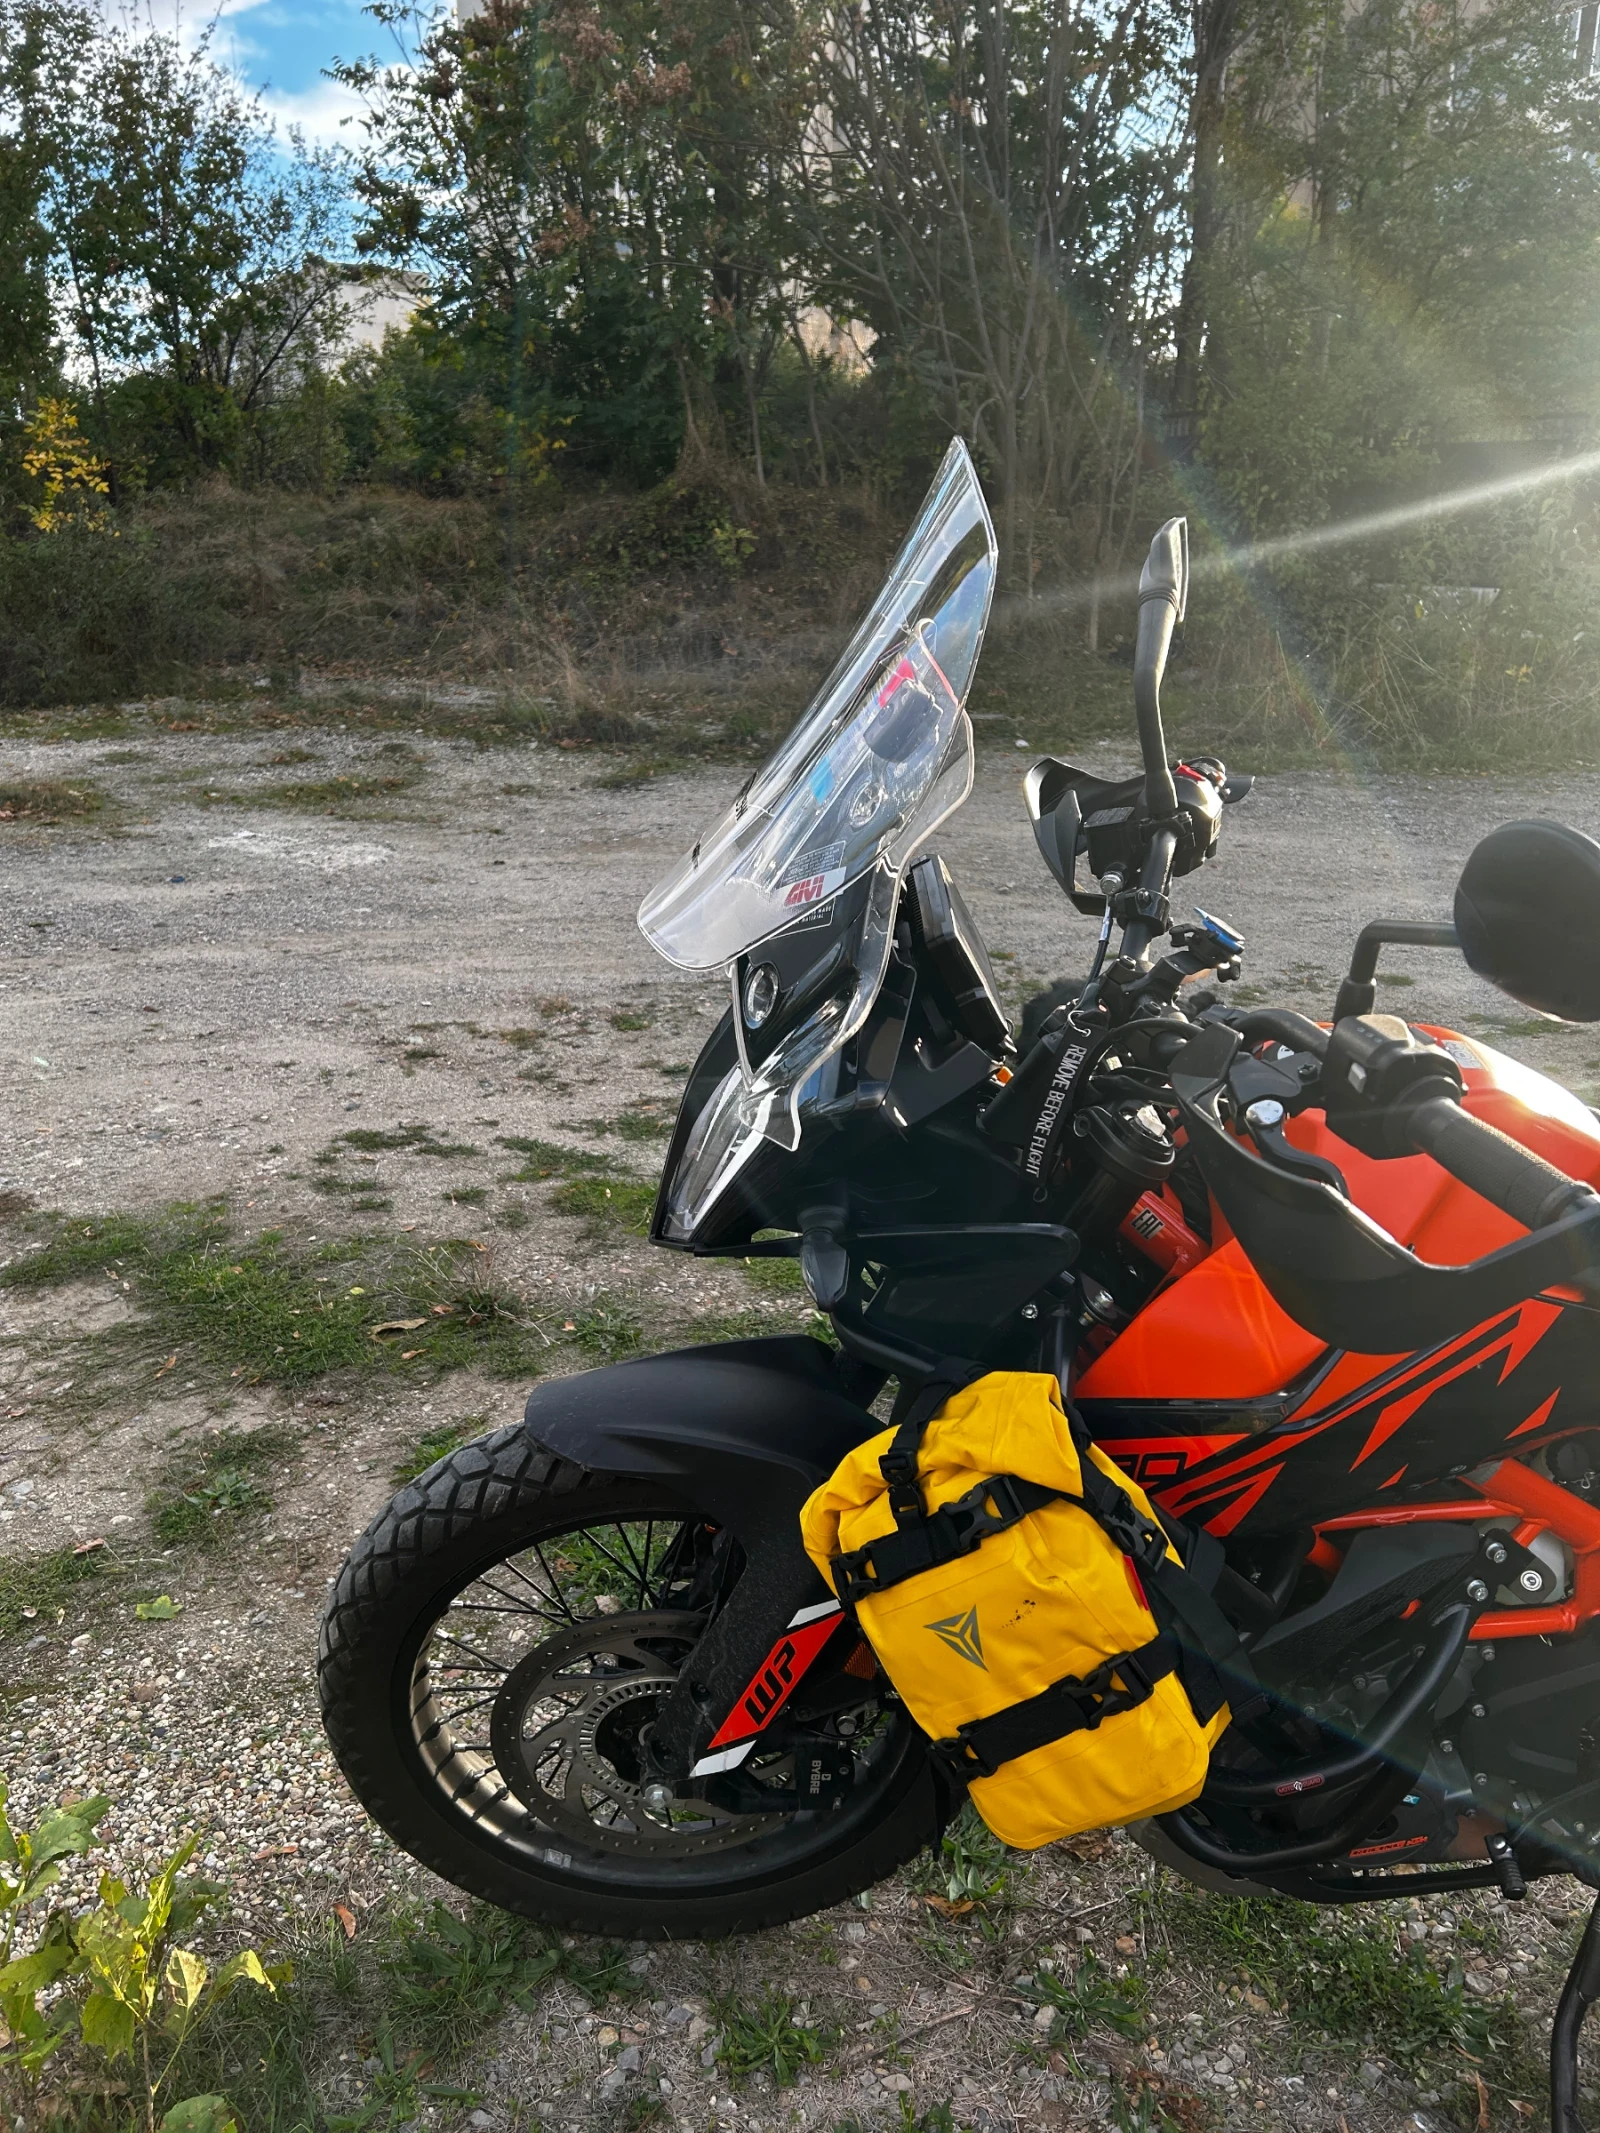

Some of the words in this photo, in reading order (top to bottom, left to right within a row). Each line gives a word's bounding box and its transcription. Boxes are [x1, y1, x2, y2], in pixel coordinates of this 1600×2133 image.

[784, 874, 825, 907] GIVI
[1052, 1043, 1088, 1091] REMOVE
[1035, 1088, 1066, 1136] BEFORE
[1025, 1134, 1048, 1178] FLIGHT
[809, 1760, 822, 1795] BYBRE
